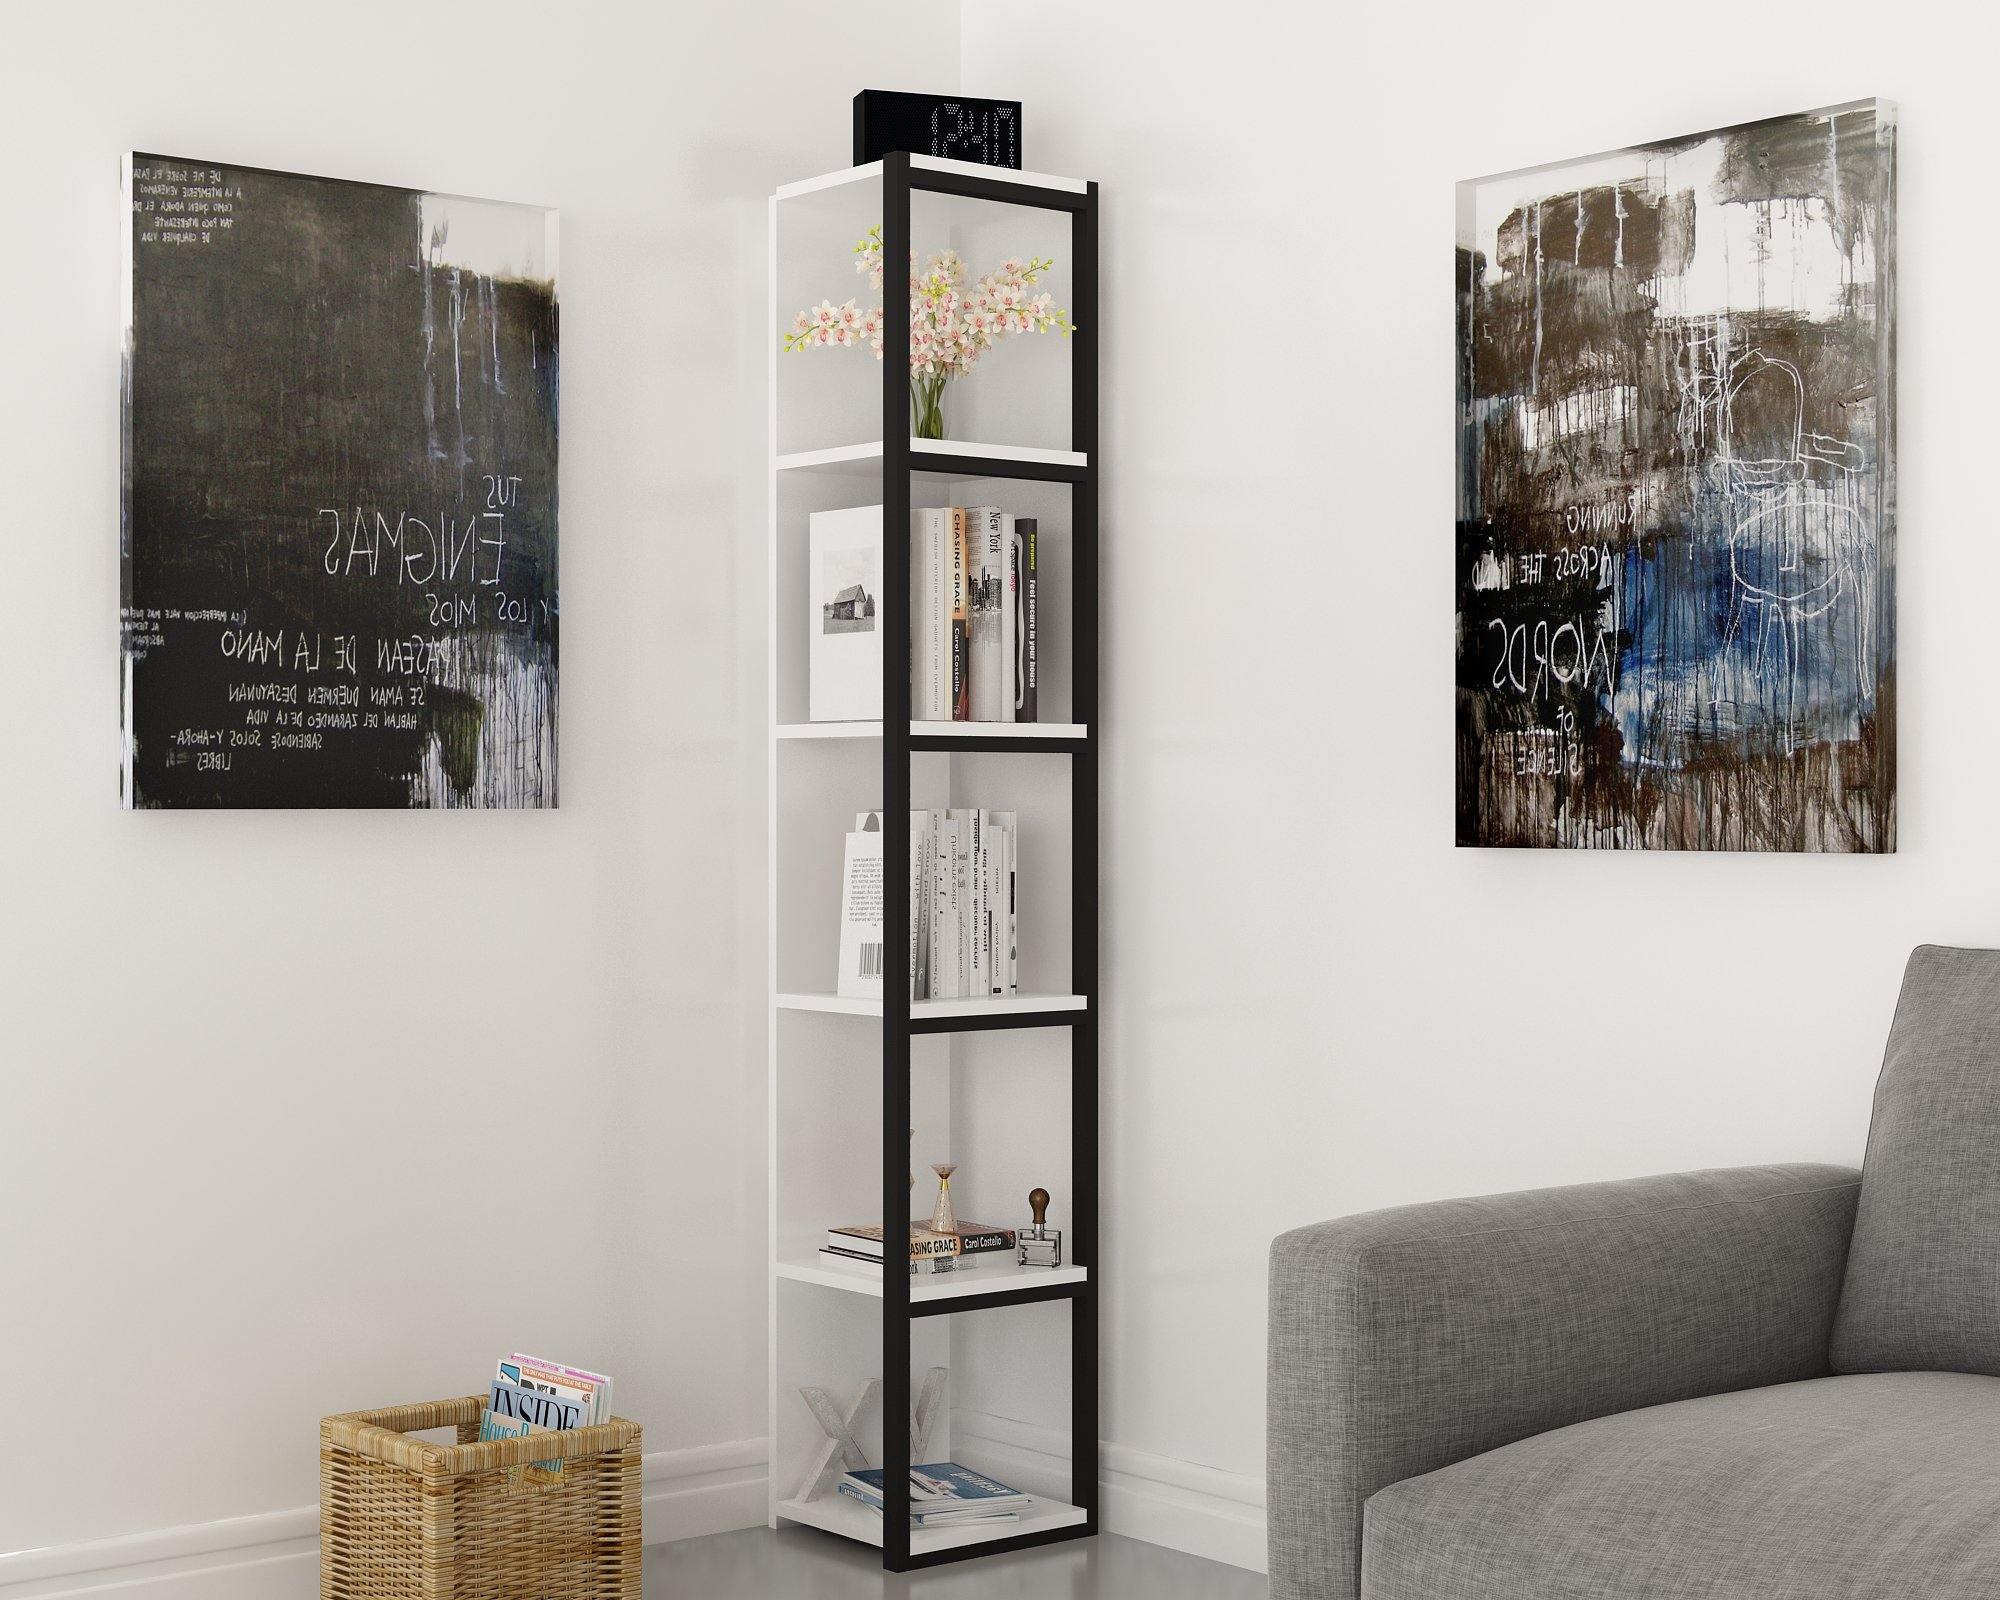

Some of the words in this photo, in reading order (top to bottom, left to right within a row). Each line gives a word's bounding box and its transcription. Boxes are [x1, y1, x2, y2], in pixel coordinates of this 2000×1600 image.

[989, 511, 1001, 531] New
[989, 533, 1002, 554] York
[1029, 630, 1036, 639] in
[933, 1238, 958, 1253] GRACE
[964, 1237, 979, 1249] Carol
[980, 1236, 1002, 1248] Costello
[493, 1386, 580, 1431] INSIDE
